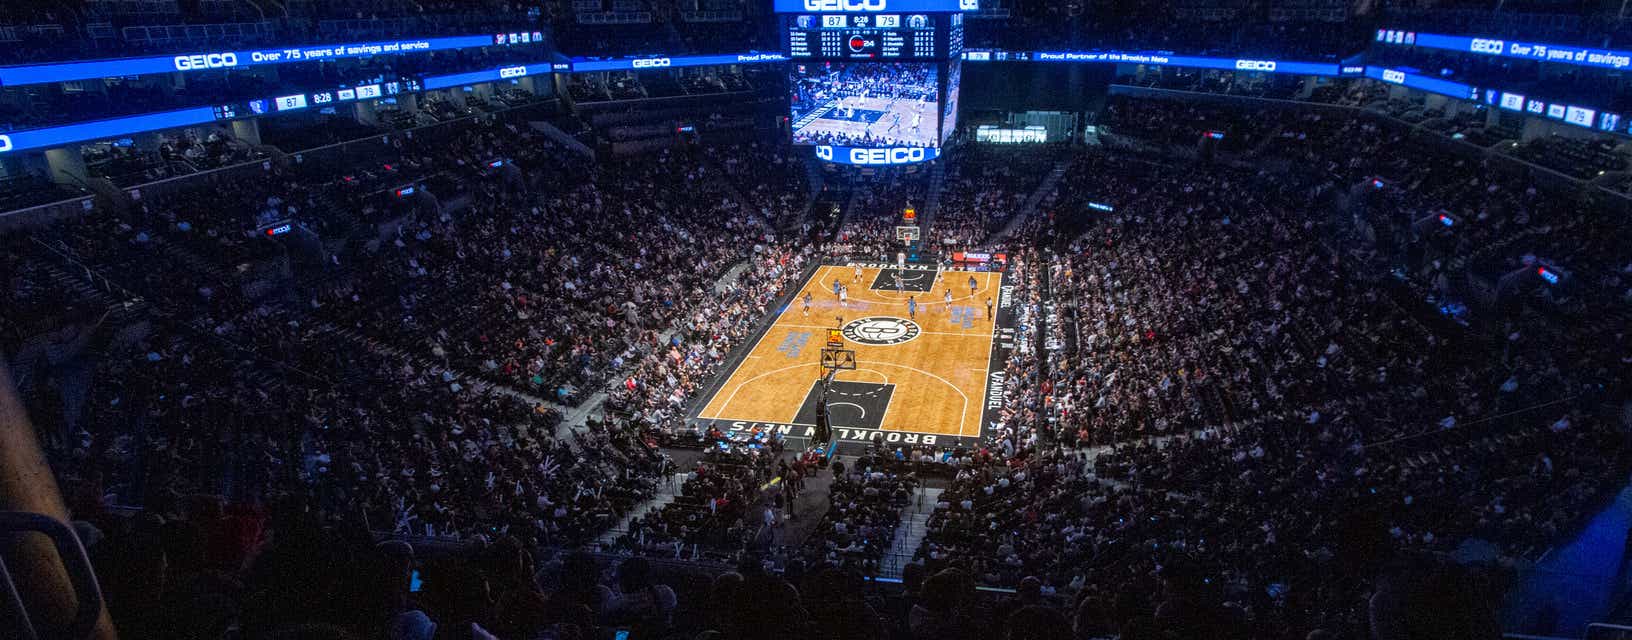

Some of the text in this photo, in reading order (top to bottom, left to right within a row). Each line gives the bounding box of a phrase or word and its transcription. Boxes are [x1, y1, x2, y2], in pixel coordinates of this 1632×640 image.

[828, 16, 841, 25] 87
[882, 16, 894, 25] 79
[174, 41, 429, 70] GEICO Over 75 years of savings and service
[1121, 54, 1149, 62] Brooklyn
[1471, 38, 1630, 67] GEICO Over 75 years of savings
[632, 58, 670, 68] GEICO
[1236, 60, 1276, 71] GEICO
[500, 66, 526, 78] GEICO
[1382, 69, 1405, 84] GEICO
[286, 98, 297, 108] 87
[313, 92, 332, 103] 8:28
[364, 88, 374, 96] 79
[1575, 110, 1585, 122] 79
[850, 148, 924, 164] GEICO
